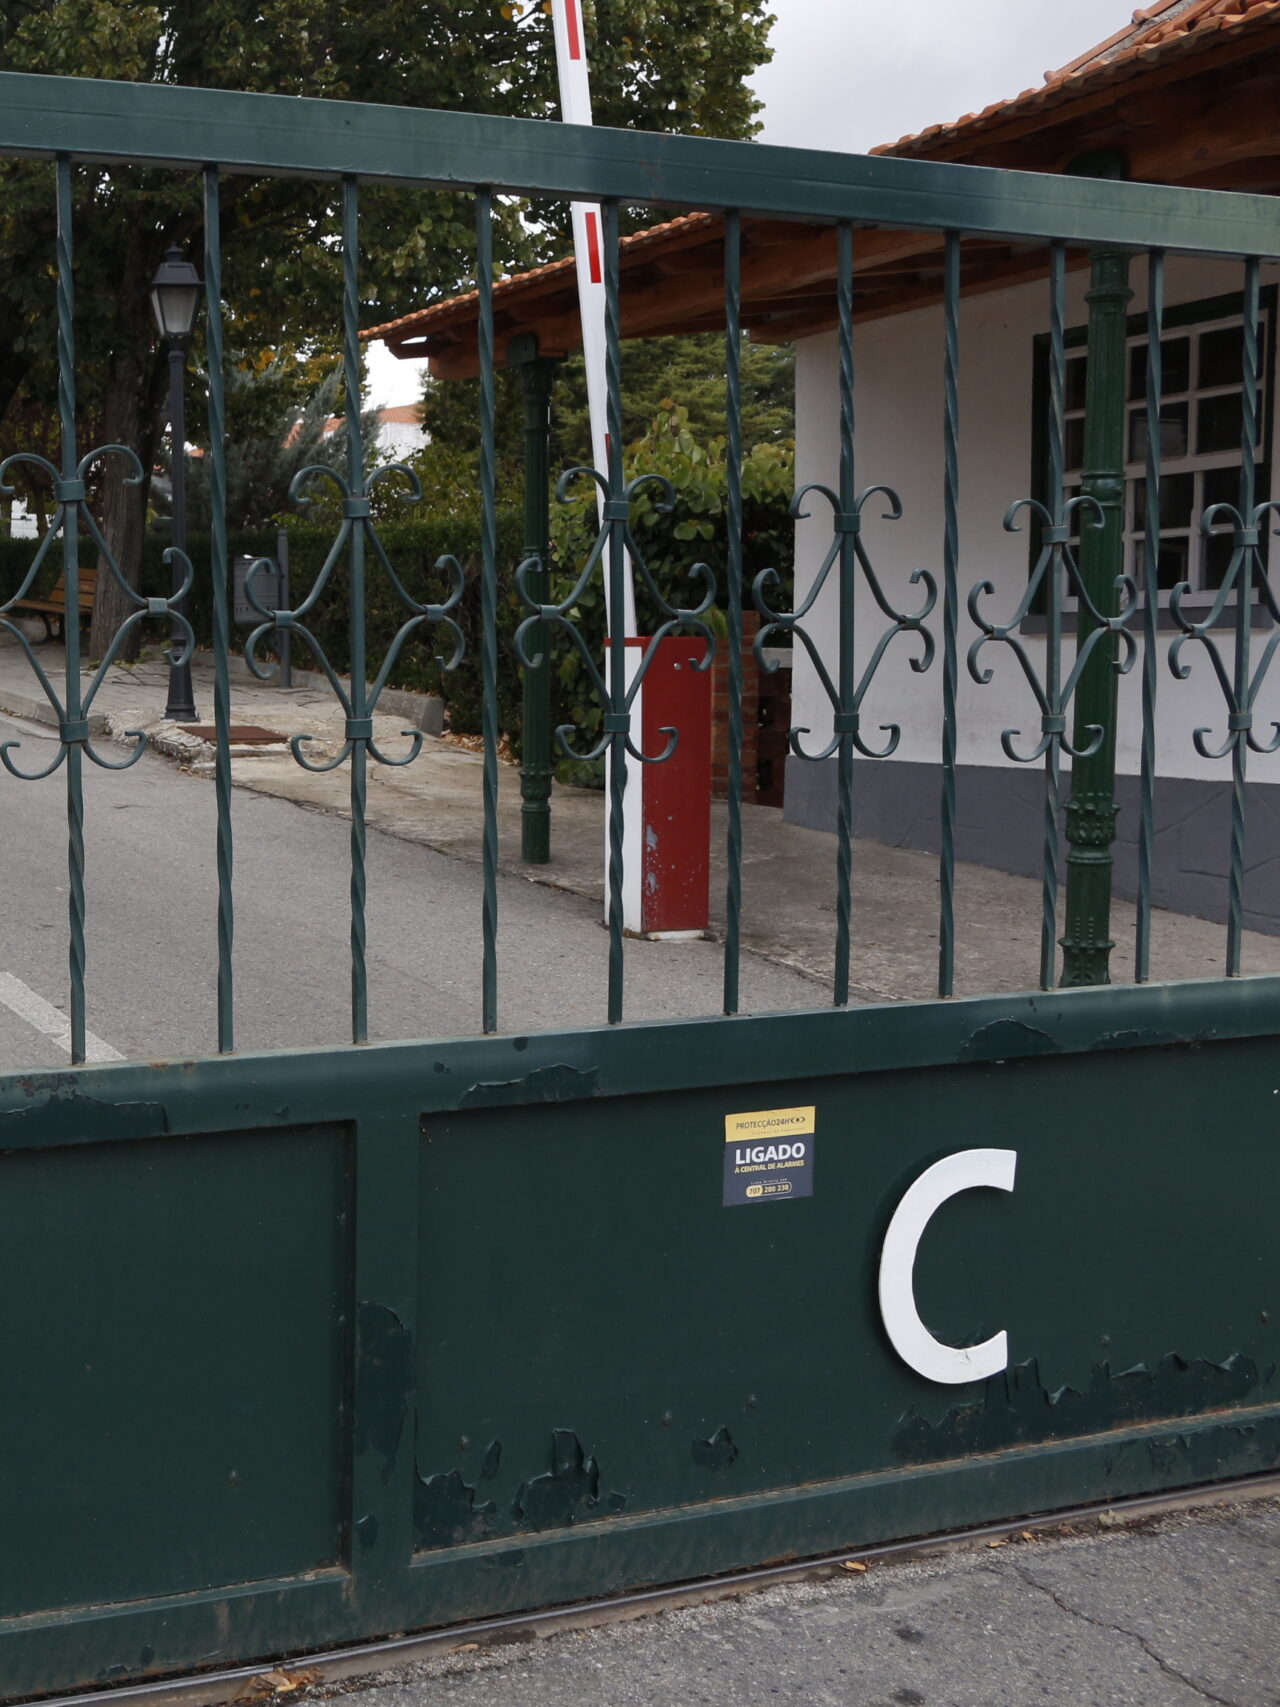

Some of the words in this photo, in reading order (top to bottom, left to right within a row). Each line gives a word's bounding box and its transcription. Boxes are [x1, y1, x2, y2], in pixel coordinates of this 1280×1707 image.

[735, 1142, 805, 1164] LIGADO
[740, 1164, 766, 1173] CENTRAL
[776, 1159, 804, 1168] ALARMES
[878, 1148, 1018, 1386] C
